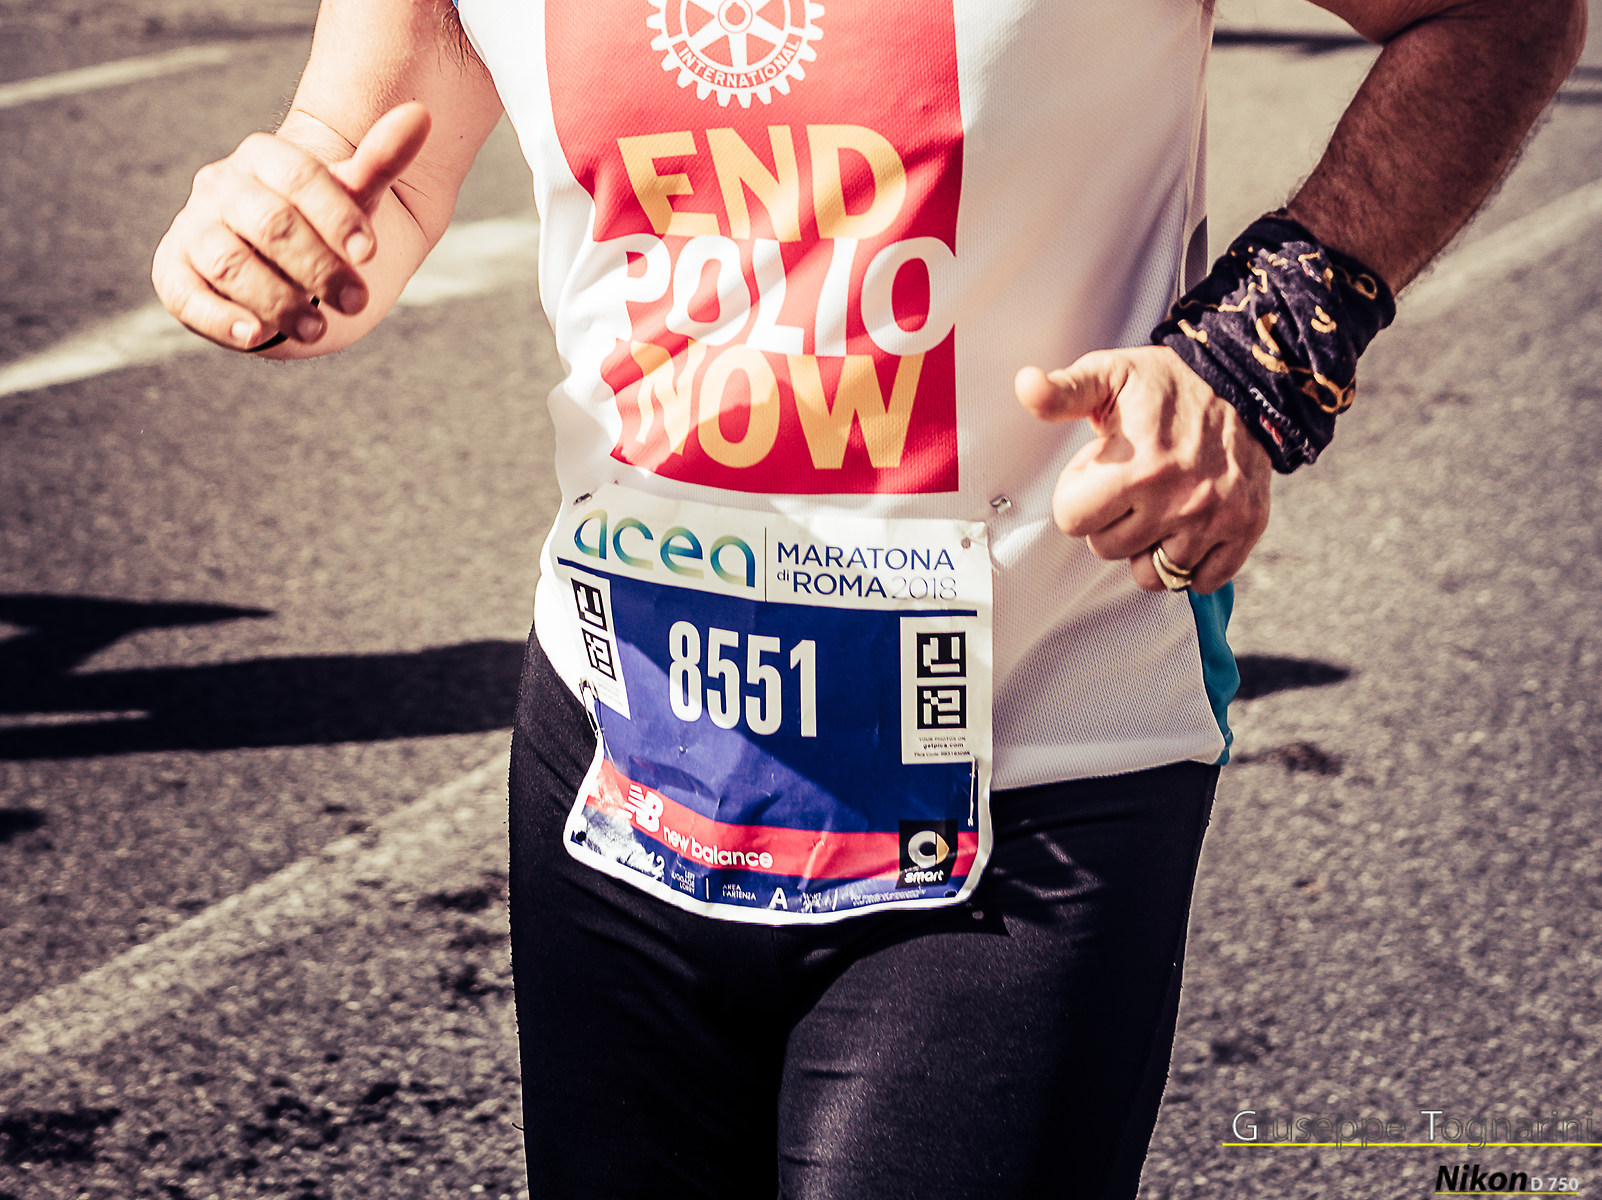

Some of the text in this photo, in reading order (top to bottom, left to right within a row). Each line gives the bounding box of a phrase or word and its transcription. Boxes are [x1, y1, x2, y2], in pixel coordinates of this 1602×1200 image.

[678, 40, 800, 88] INTERNATIONAL
[616, 124, 907, 243] END
[600, 233, 956, 357] POLIO
[628, 338, 926, 469] NOW
[574, 508, 756, 588] acea
[777, 542, 955, 571] MARATONA
[777, 569, 957, 601] di ROMA 2018
[669, 620, 817, 738] 8551
[663, 825, 774, 869] new balance
[904, 869, 944, 884] smart
